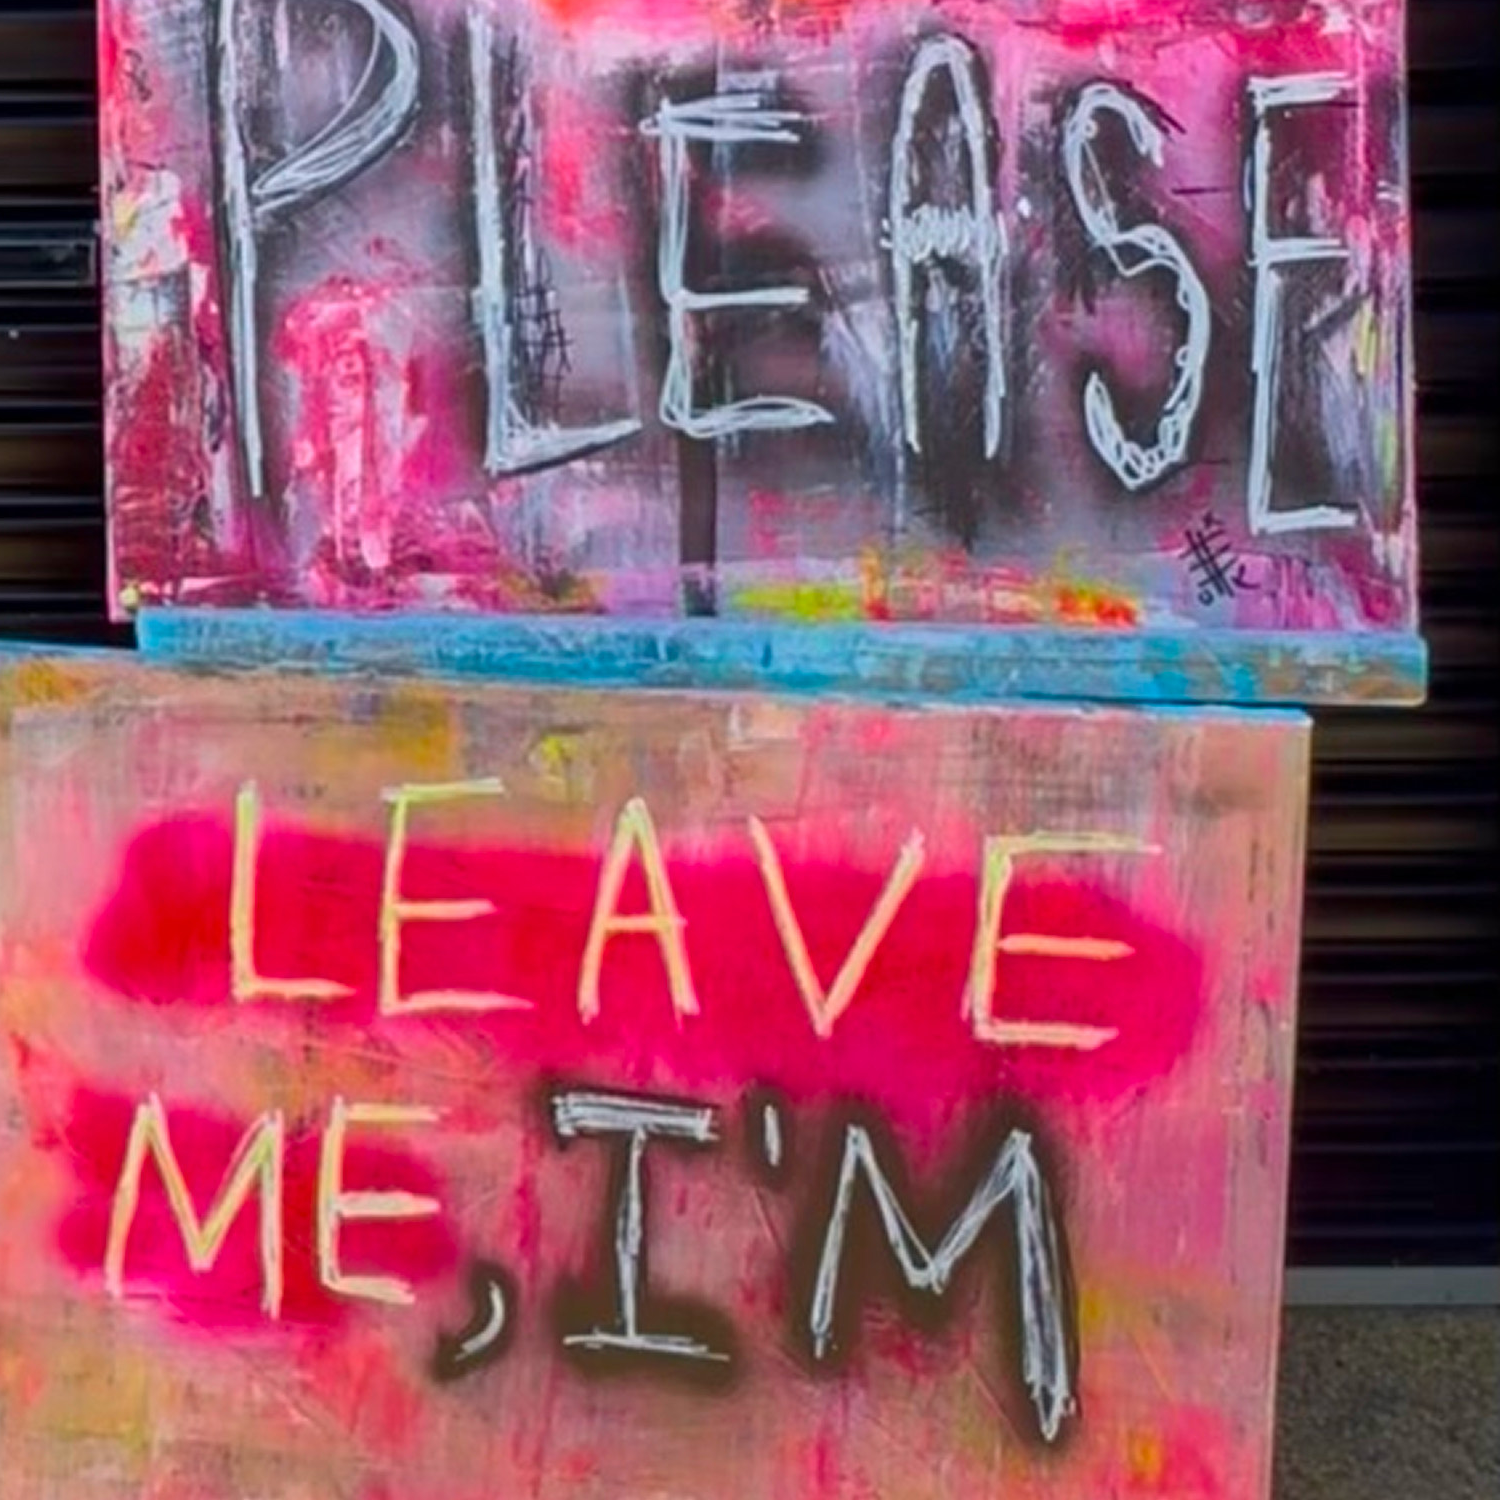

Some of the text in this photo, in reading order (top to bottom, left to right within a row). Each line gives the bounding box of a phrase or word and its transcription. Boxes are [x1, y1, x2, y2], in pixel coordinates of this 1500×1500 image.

[226, 776, 1164, 1050] LEAVE
[102, 1090, 1080, 1444] ME, I'M
